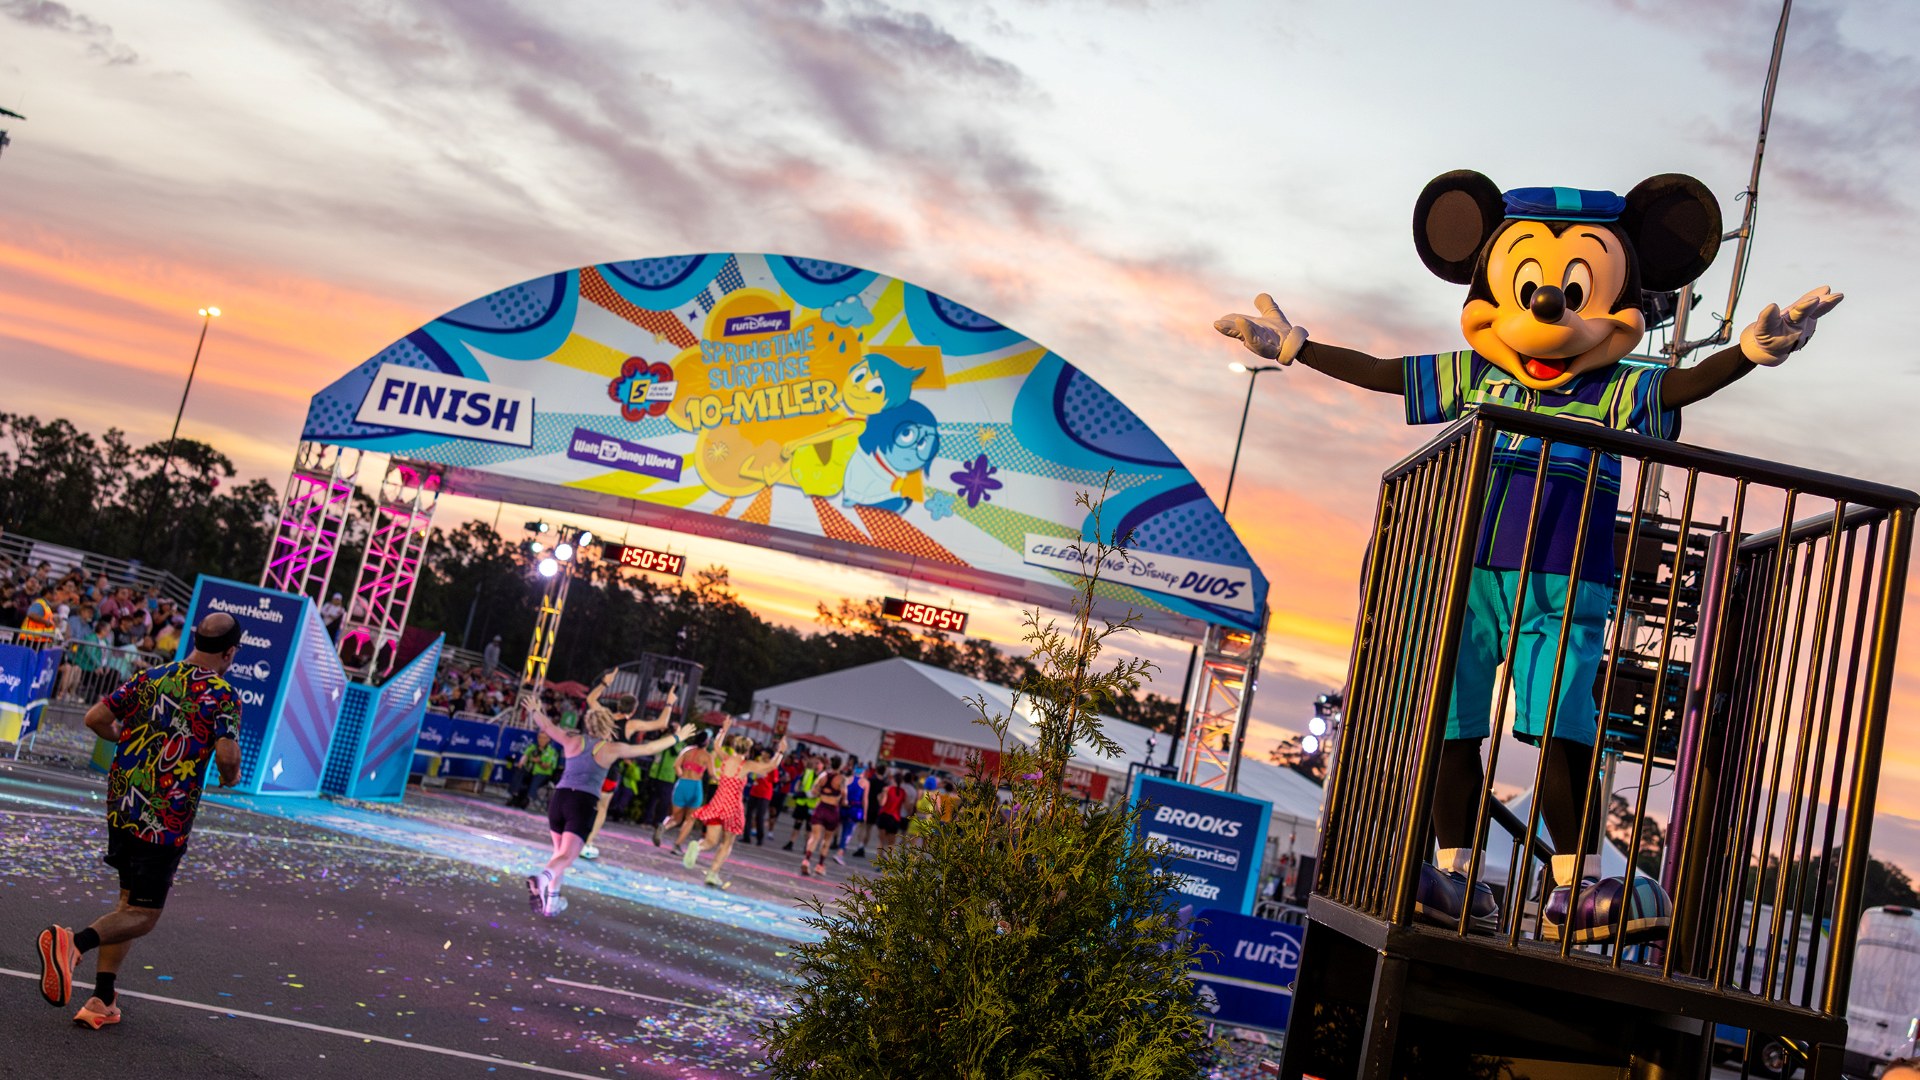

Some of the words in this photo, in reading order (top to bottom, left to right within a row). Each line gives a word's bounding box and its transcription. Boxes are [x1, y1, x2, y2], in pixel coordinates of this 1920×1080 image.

[700, 325, 815, 365] SPRINGTIME
[633, 384, 647, 399] 5
[708, 356, 811, 390] SURPRISE
[378, 378, 520, 432] FINISH
[685, 379, 840, 431] 10-MILER
[574, 440, 600, 455] Walt
[645, 453, 677, 470] World
[1127, 555, 1180, 588] Disney
[1179, 571, 1247, 600] DUOS
[1154, 805, 1243, 838] BROOKS
